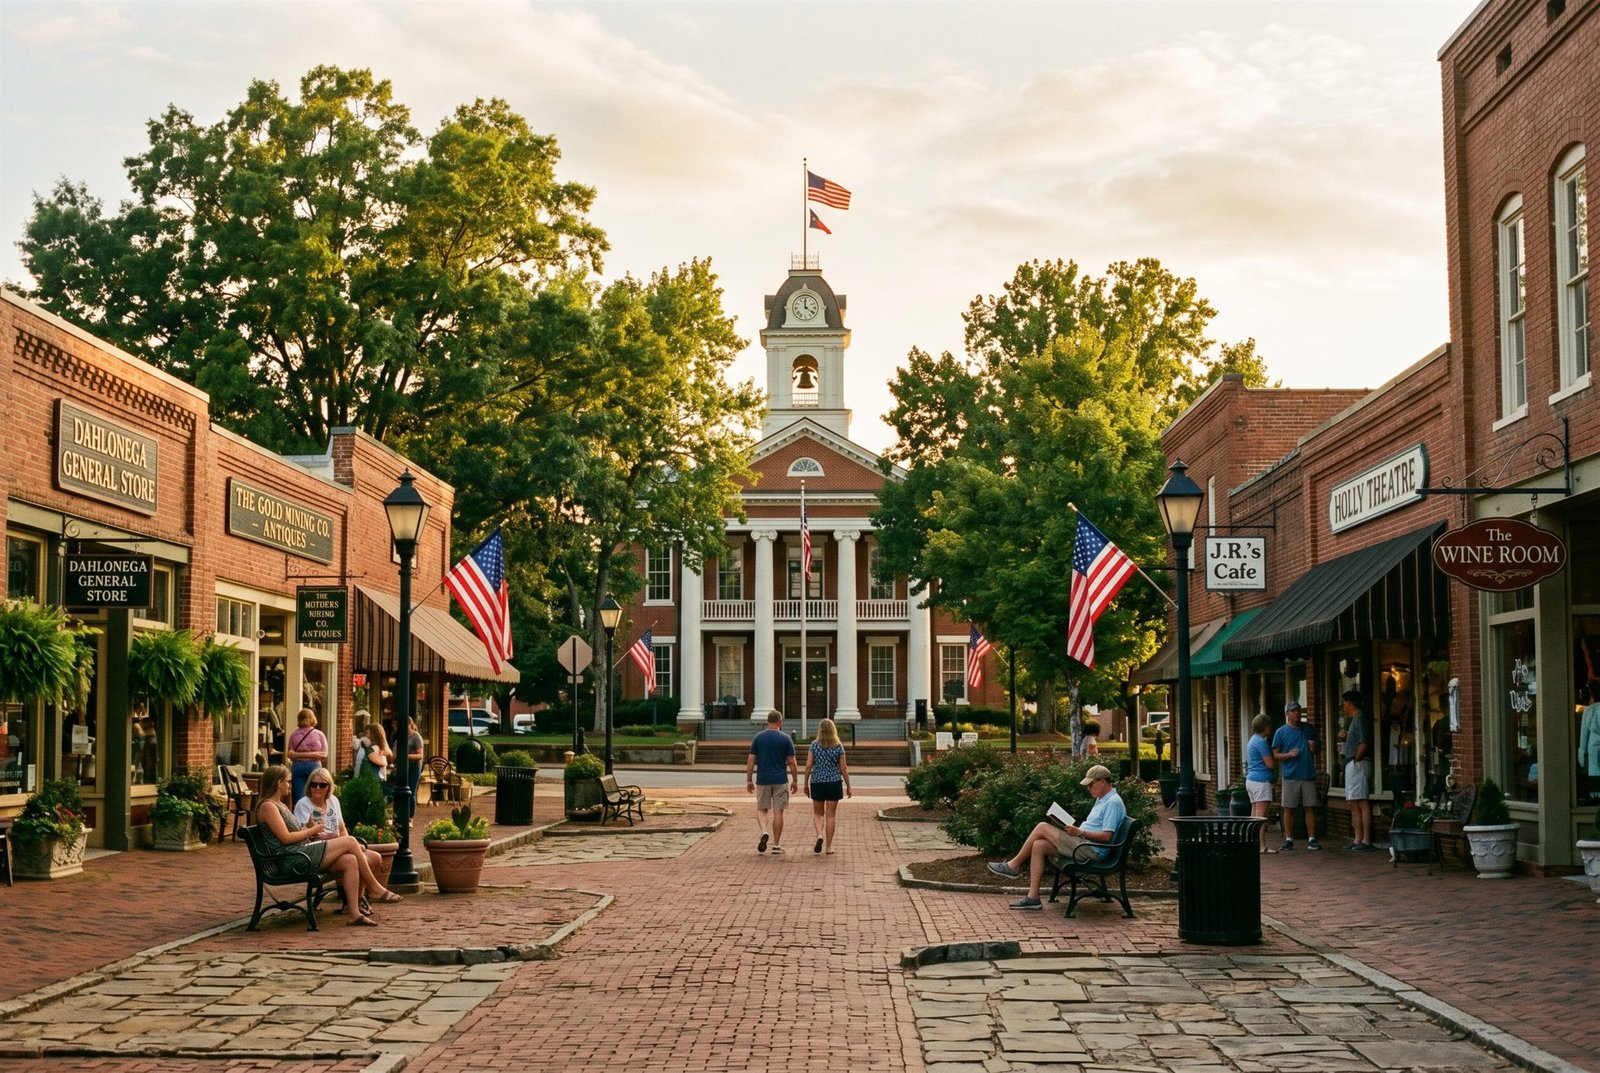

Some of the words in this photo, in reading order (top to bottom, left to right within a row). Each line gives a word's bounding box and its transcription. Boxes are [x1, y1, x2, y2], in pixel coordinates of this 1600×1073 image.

[73, 417, 147, 469] DAHLONEGA
[63, 450, 118, 491] GENERAL
[121, 470, 155, 503] STORE
[1335, 482, 1364, 523] HOLLY
[1366, 457, 1416, 509] THEATRE
[236, 487, 255, 511] THE
[258, 496, 282, 520] GOLD
[285, 506, 315, 532] MINING
[317, 519, 330, 538] CO.
[263, 520, 306, 548] ANTIQUES
[1486, 528, 1512, 541] The
[1210, 542, 1261, 559] J.R.'s
[1440, 545, 1494, 563] WINE
[1498, 545, 1559, 563] ROOM
[69, 560, 148, 572] DAHLONEGA
[1214, 562, 1257, 579] Cafe
[78, 575, 137, 587] GENERAL
[87, 590, 128, 602] STORE
[302, 630, 342, 639] ANTIQUES
